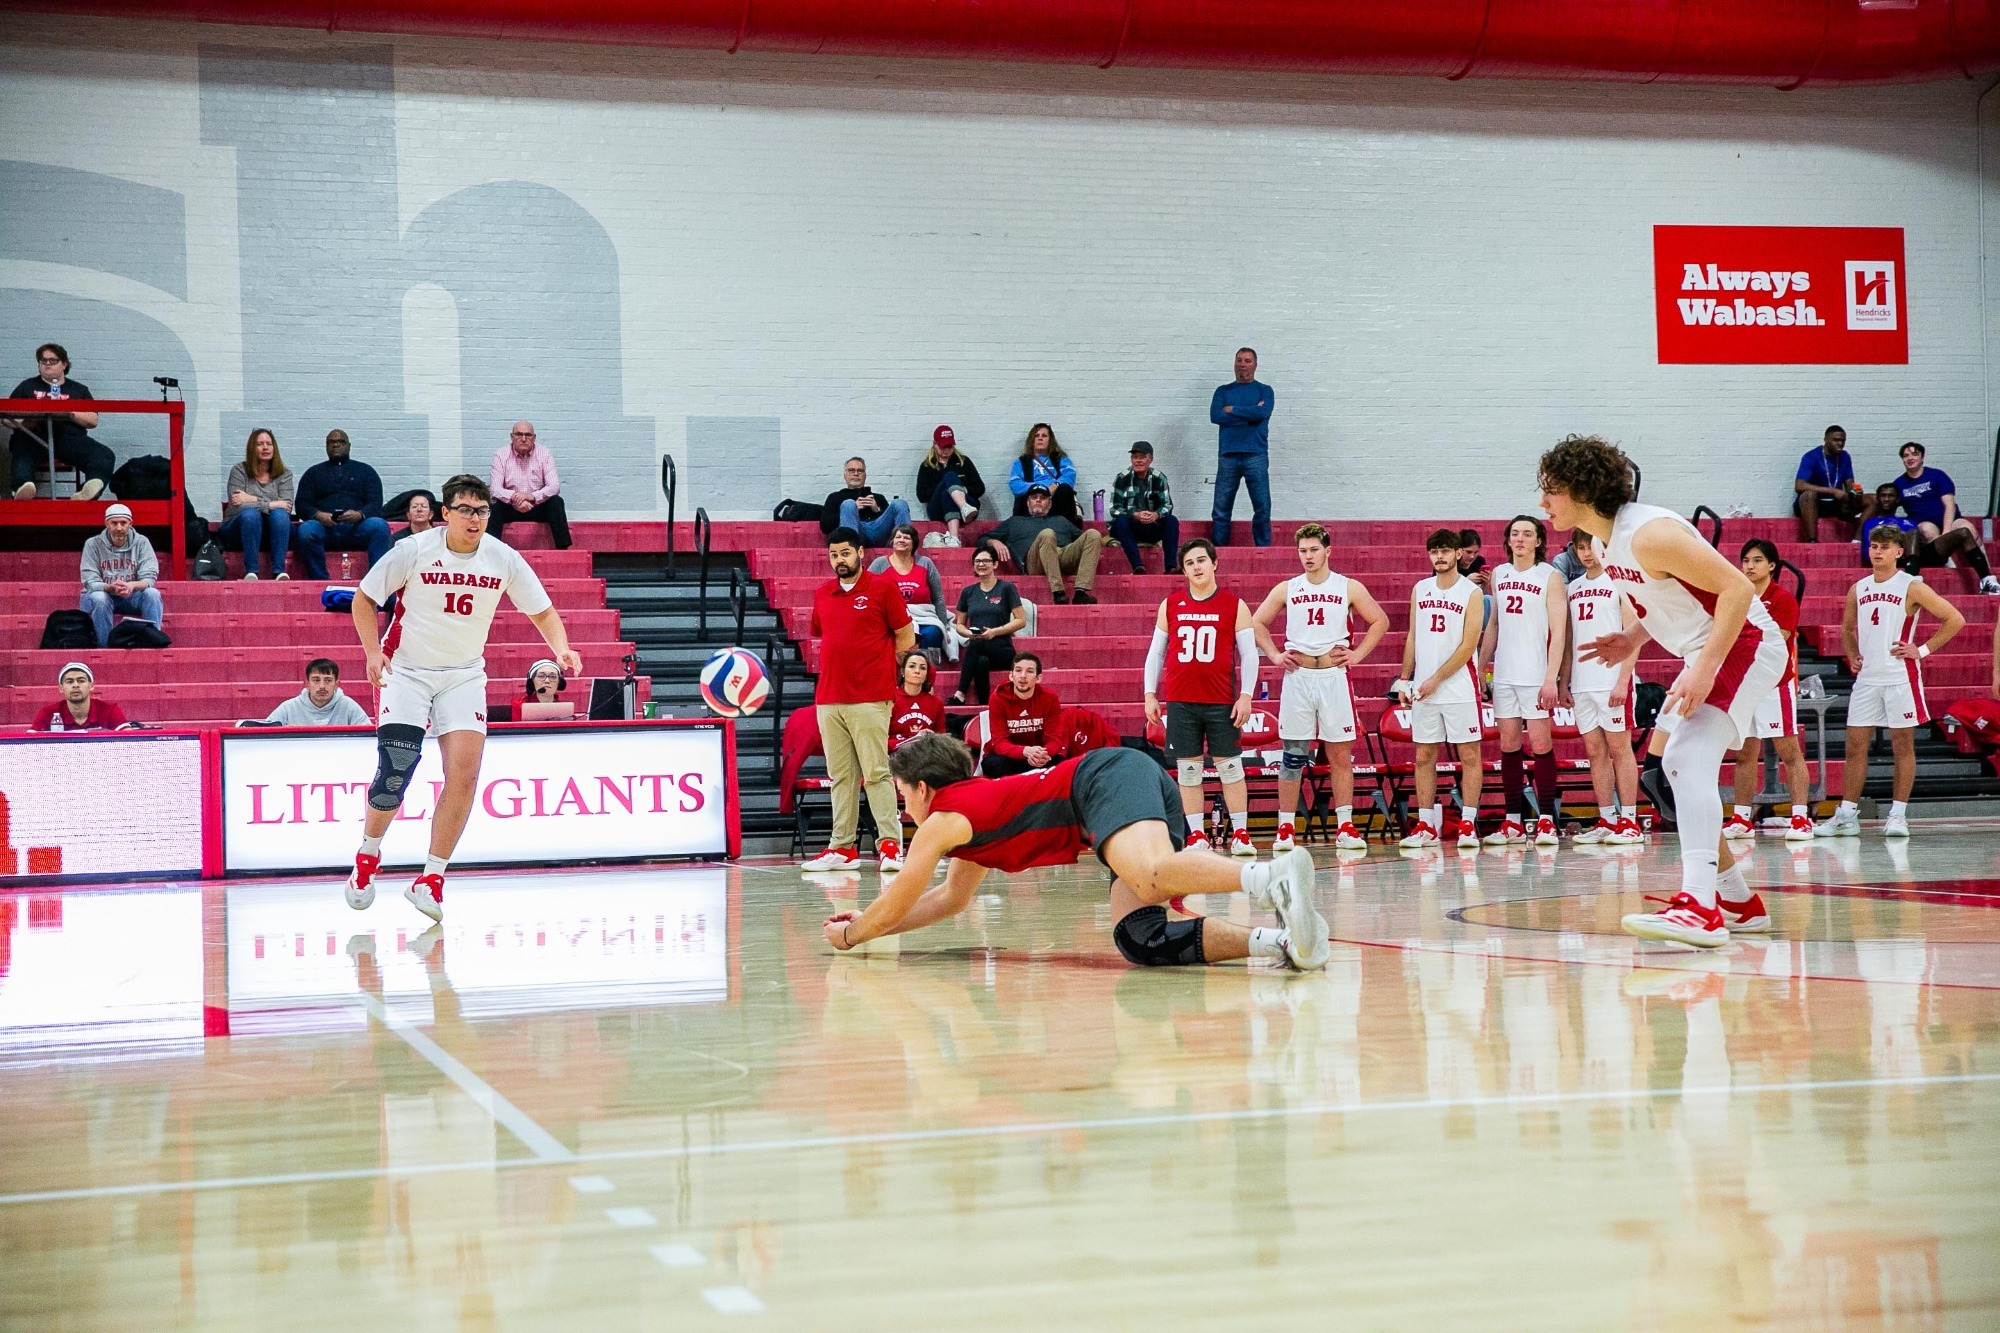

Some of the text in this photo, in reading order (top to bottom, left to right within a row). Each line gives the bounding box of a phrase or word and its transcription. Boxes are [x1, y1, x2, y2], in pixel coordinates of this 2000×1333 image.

[1681, 263, 1810, 298] Always
[1676, 298, 1825, 326] Wabash.
[1855, 308, 1891, 317] Hendricks
[420, 572, 502, 590] WABASH
[1498, 581, 1542, 596] WABASH
[443, 592, 474, 616] 16
[1291, 594, 1343, 605] WABASH
[1505, 595, 1523, 614] 22
[1569, 588, 1613, 603] WABASH
[1859, 592, 1903, 606] WABASH
[1418, 599, 1464, 615] WABASH
[1578, 602, 1594, 621] 12
[1871, 606, 1880, 626] 4
[1177, 613, 1220, 622] WABASH
[1307, 607, 1325, 626] 14
[1430, 613, 1446, 633] 13
[1177, 625, 1217, 663] 30
[1007, 717, 1044, 728] WABASH
[1352, 765, 1377, 773] abash
[1436, 763, 1456, 772] bash
[245, 772, 705, 825] LITTL GIANTS
